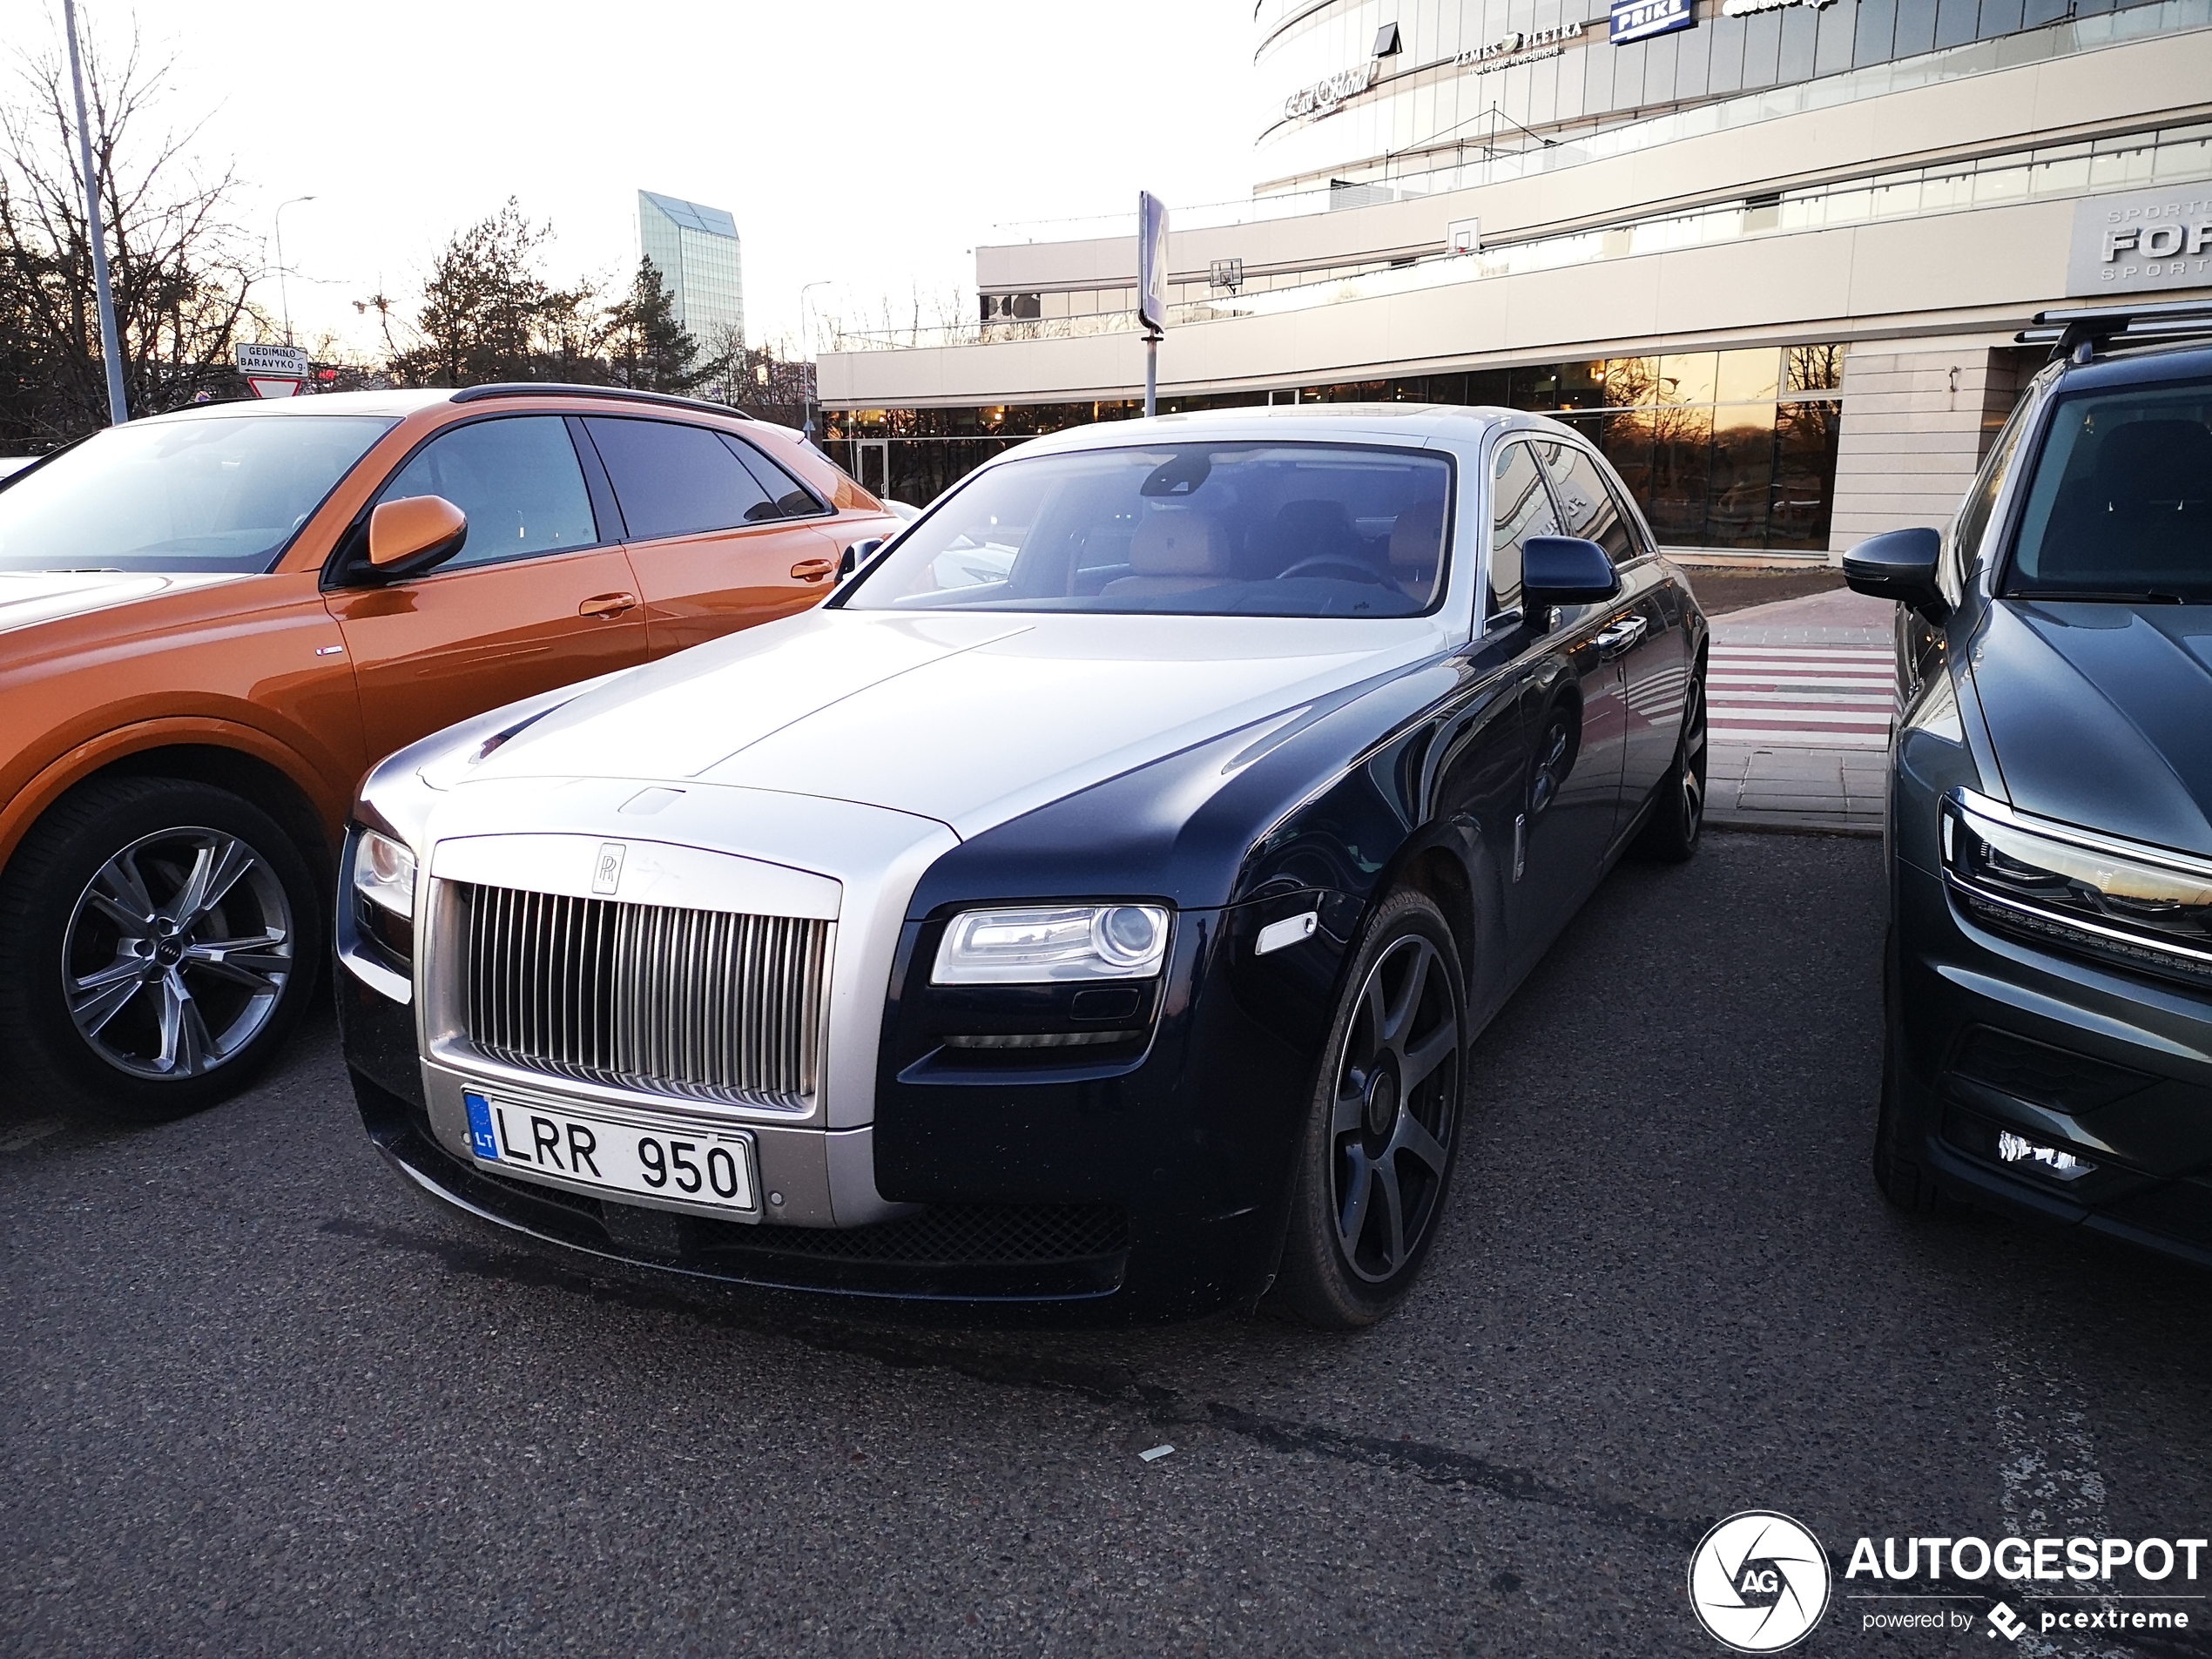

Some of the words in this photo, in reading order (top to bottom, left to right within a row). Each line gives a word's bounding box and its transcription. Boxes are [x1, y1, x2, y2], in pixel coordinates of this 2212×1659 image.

[1468, 62, 1485, 75] real
[1485, 57, 1510, 71] estate
[1510, 44, 1560, 64] investment
[249, 346, 296, 358] GEDIMINO
[240, 357, 294, 369] BARAVYKO
[475, 1130, 494, 1149] LT
[496, 1107, 602, 1178] LRR
[637, 1136, 738, 1199] 950
